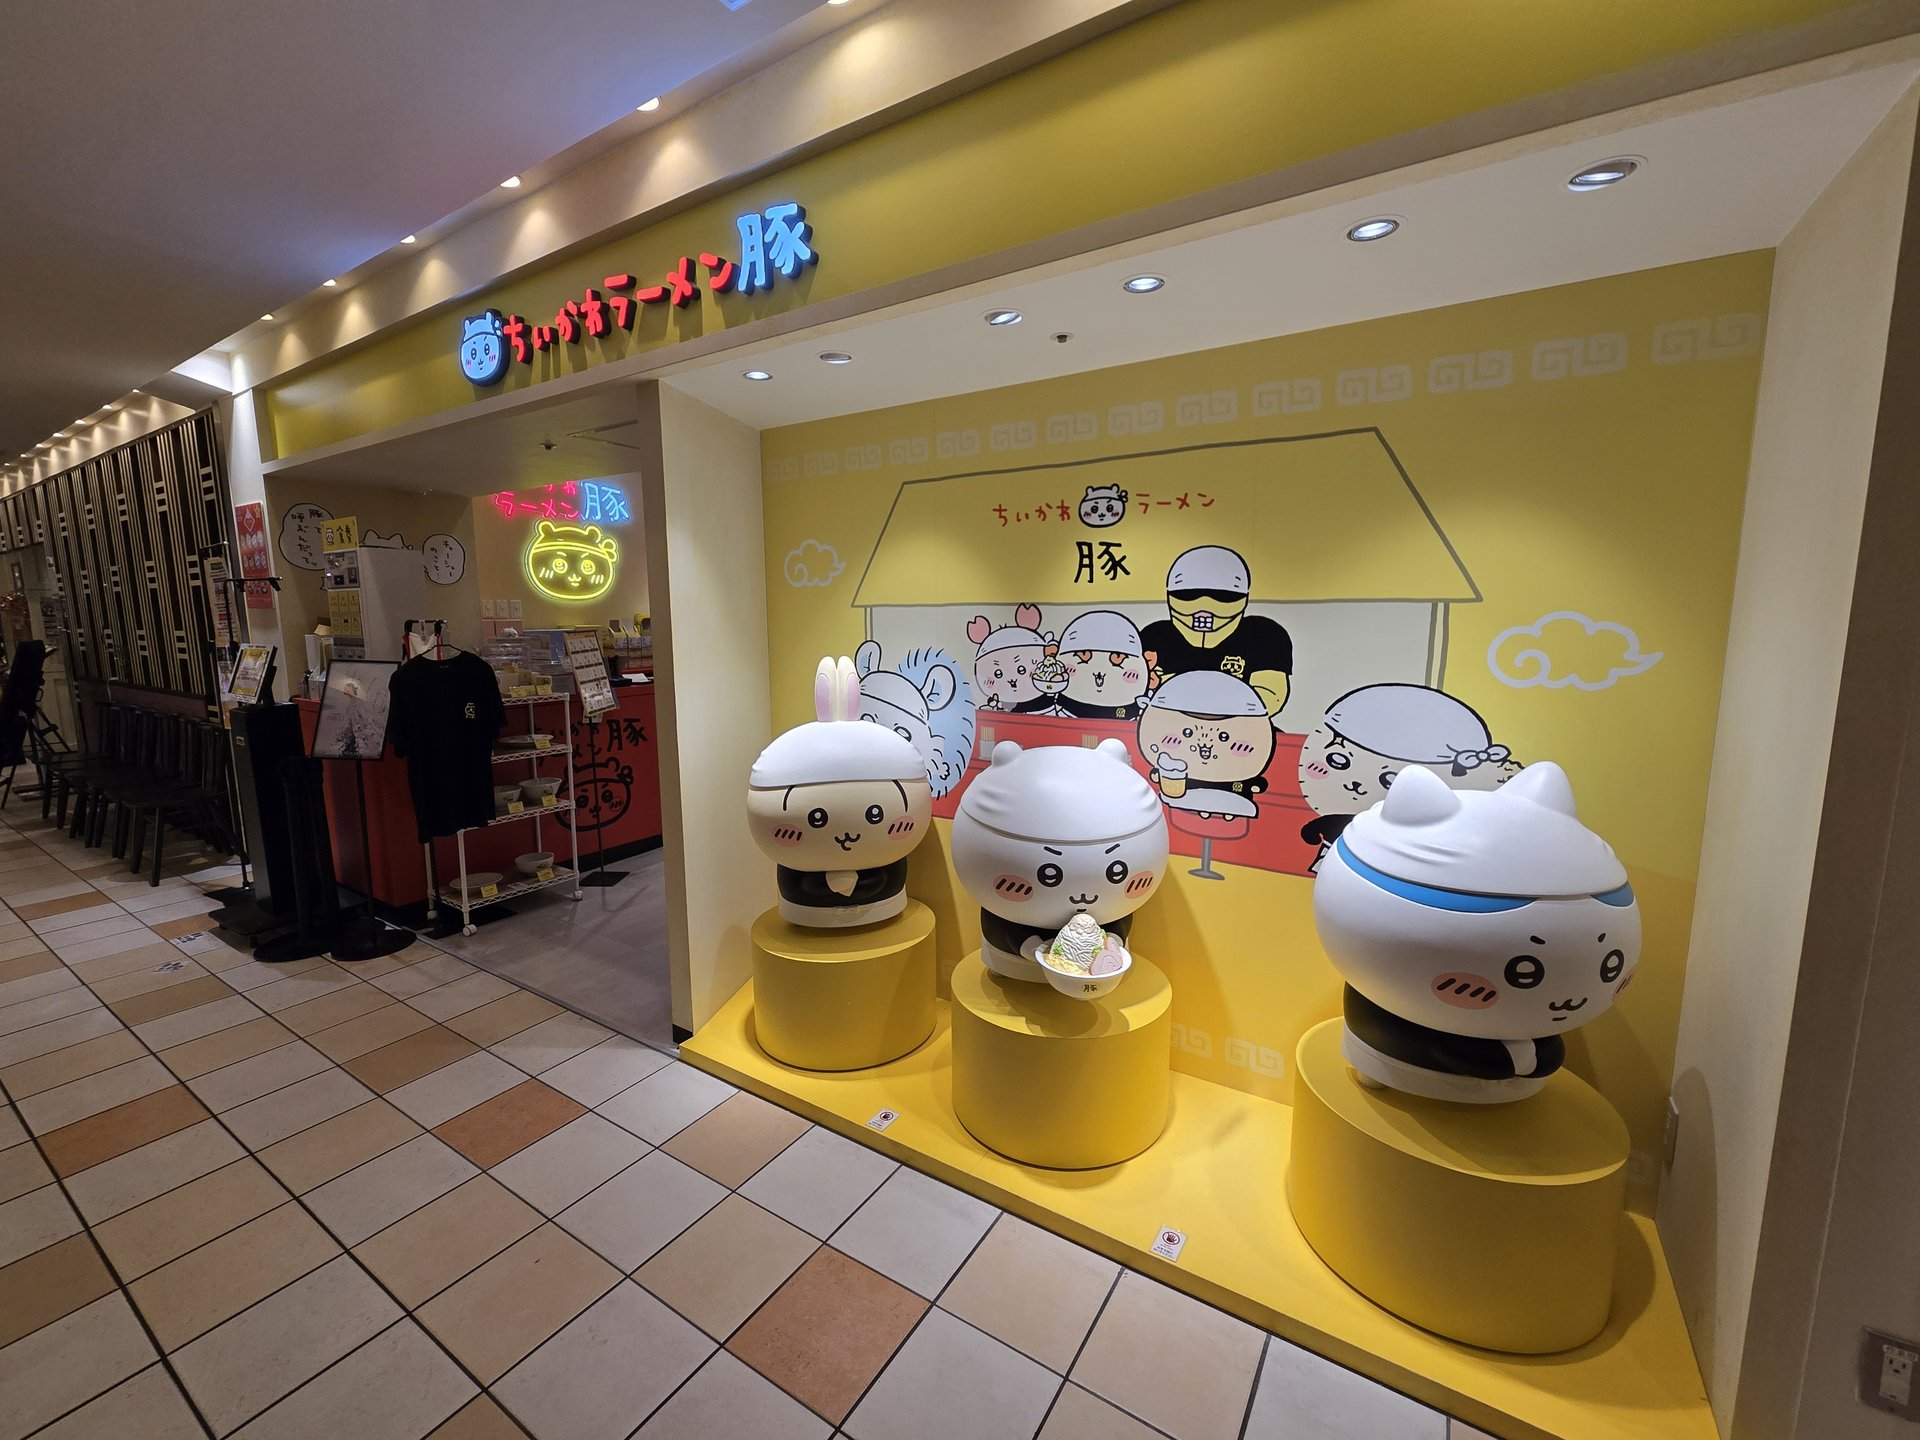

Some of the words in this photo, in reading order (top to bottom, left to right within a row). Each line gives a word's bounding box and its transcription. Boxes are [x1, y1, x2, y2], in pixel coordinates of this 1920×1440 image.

[582, 482, 630, 521] 豚
[992, 500, 1070, 527] ちいかわ
[1135, 492, 1215, 514] ラーメン
[1074, 541, 1130, 583] 豚
[606, 718, 648, 752] 豚
[1083, 984, 1098, 993] 豚
